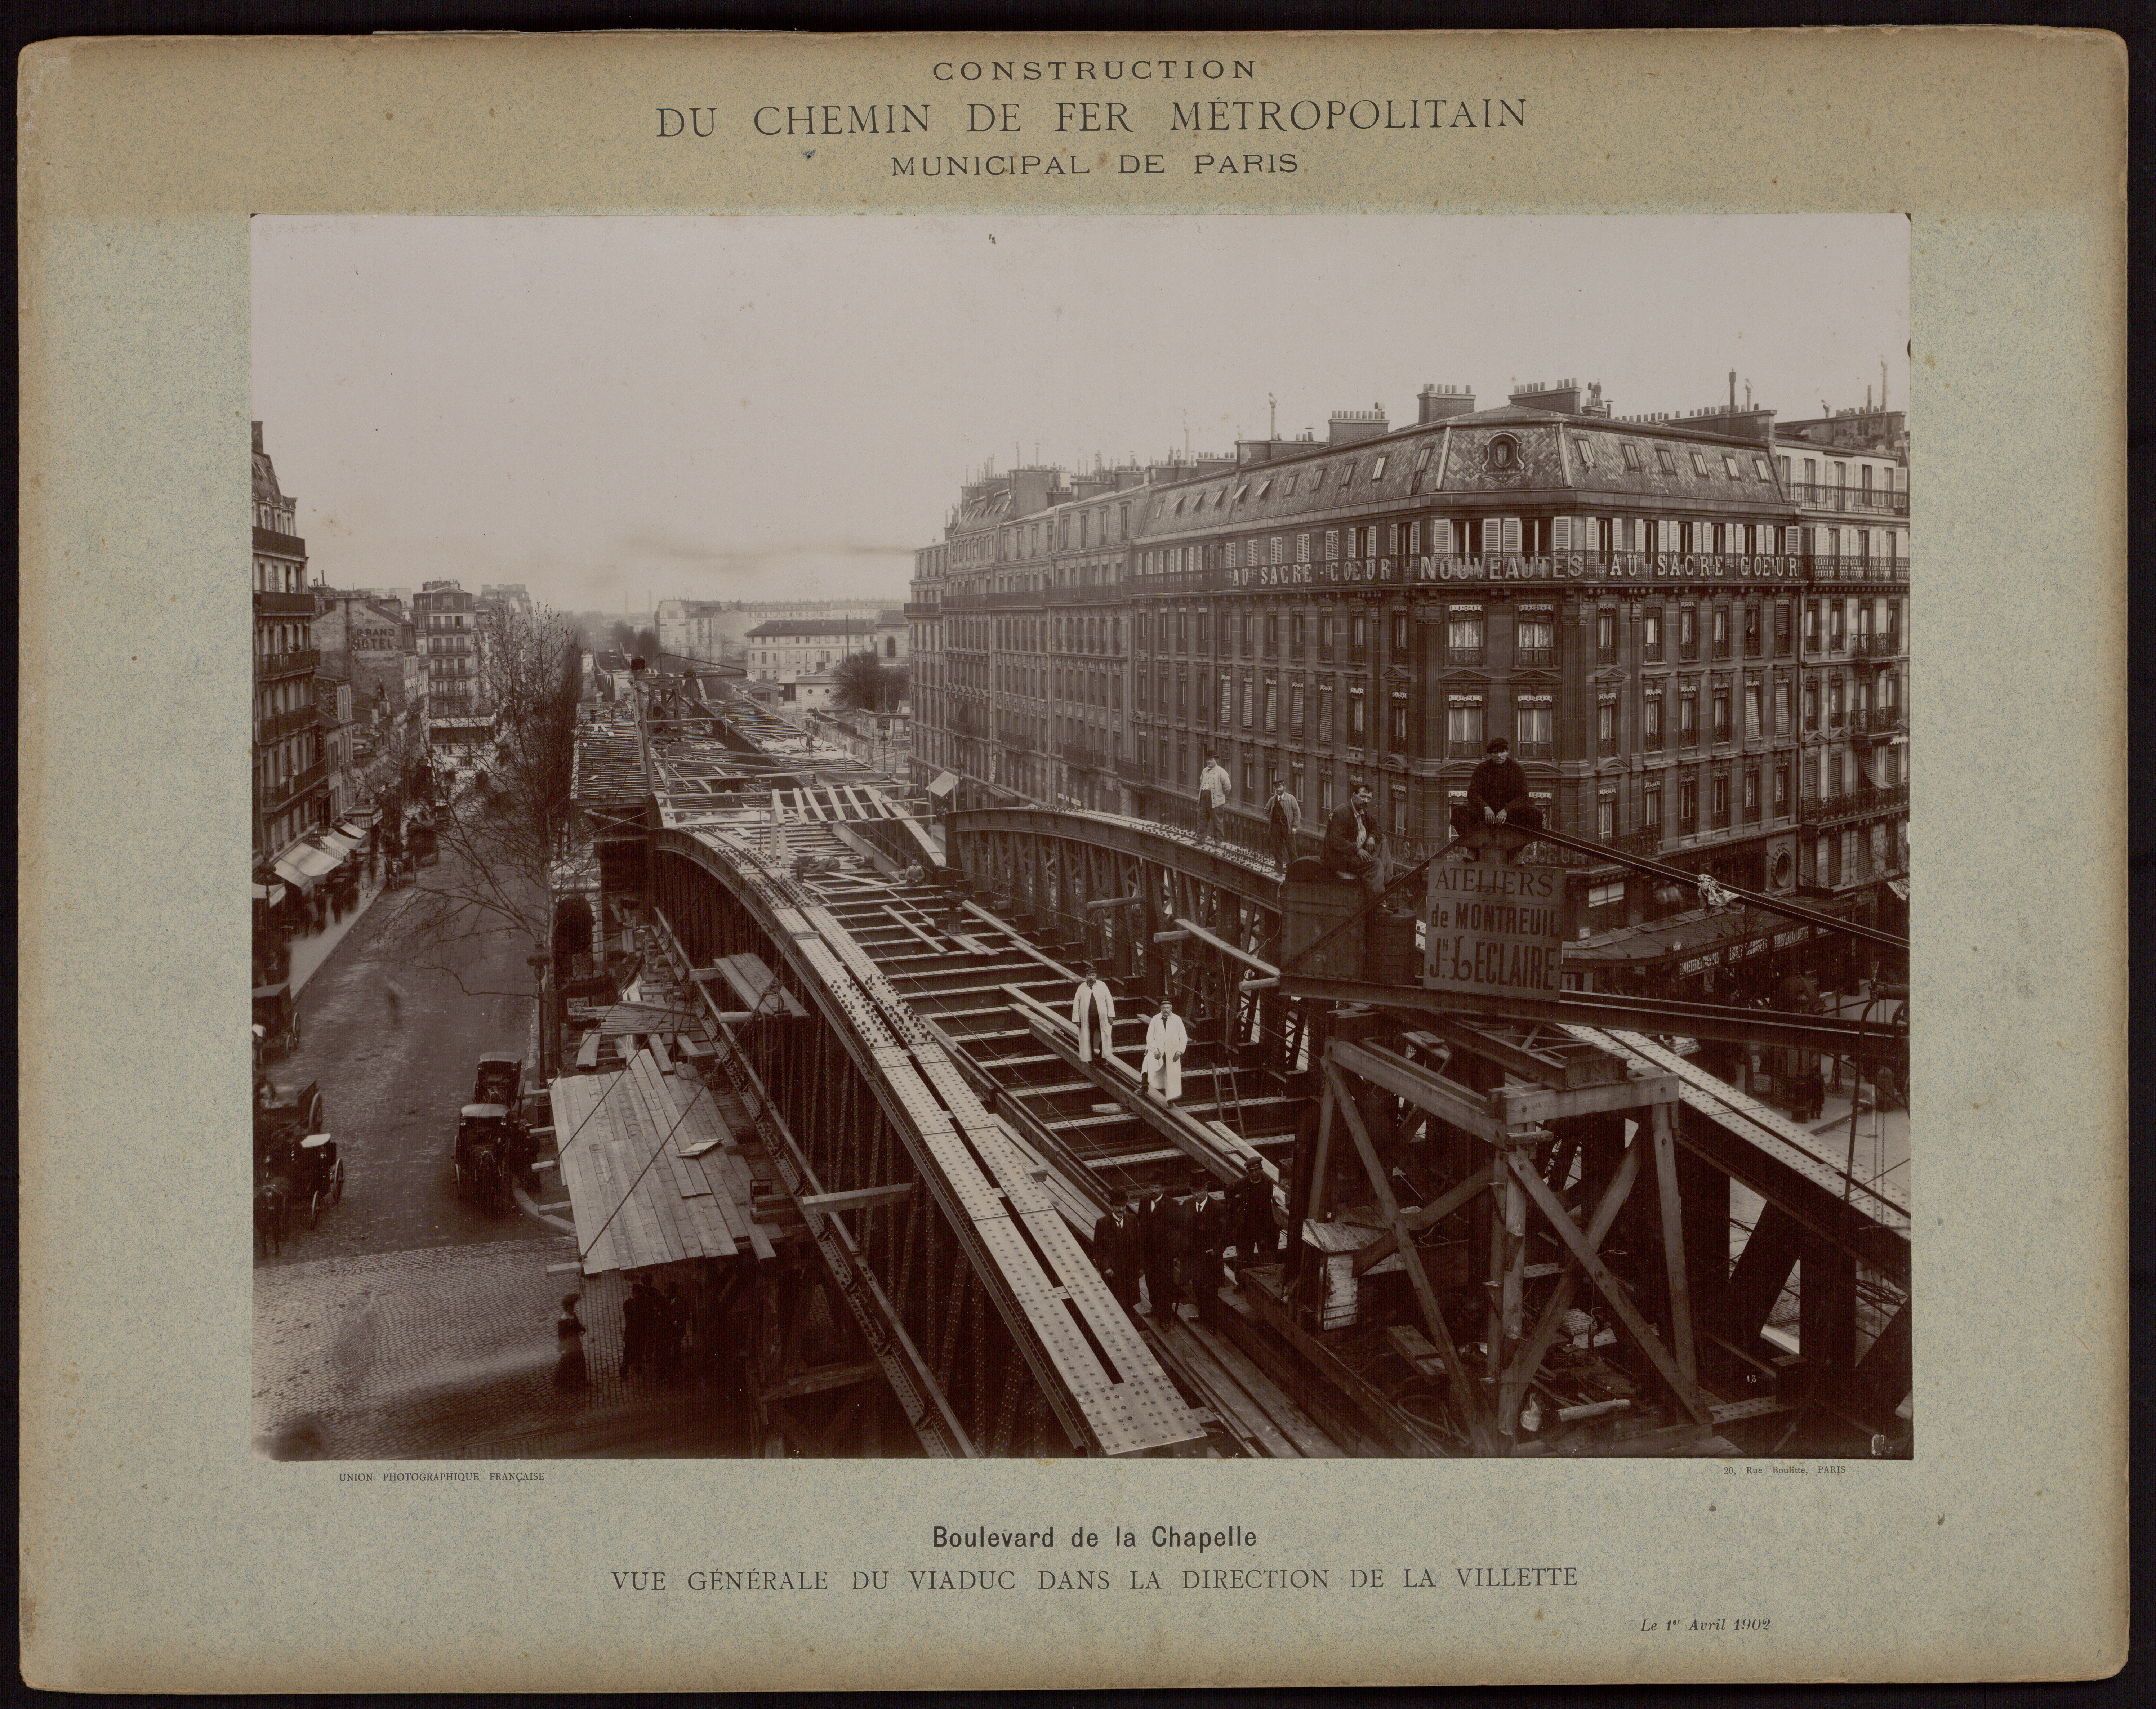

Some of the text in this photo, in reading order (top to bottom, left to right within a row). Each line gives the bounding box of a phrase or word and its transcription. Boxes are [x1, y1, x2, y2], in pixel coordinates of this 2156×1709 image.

[1233, 568, 1249, 586] AU
[1420, 555, 1583, 581] NOUVEAUTES
[1610, 553, 1638, 576] AU
[877, 718, 890, 730] DUFAYEL
[1433, 866, 1553, 897] ATELIERS
[1431, 902, 1559, 937] de MONTREUIL
[1449, 936, 1556, 990] LECLAIRE
